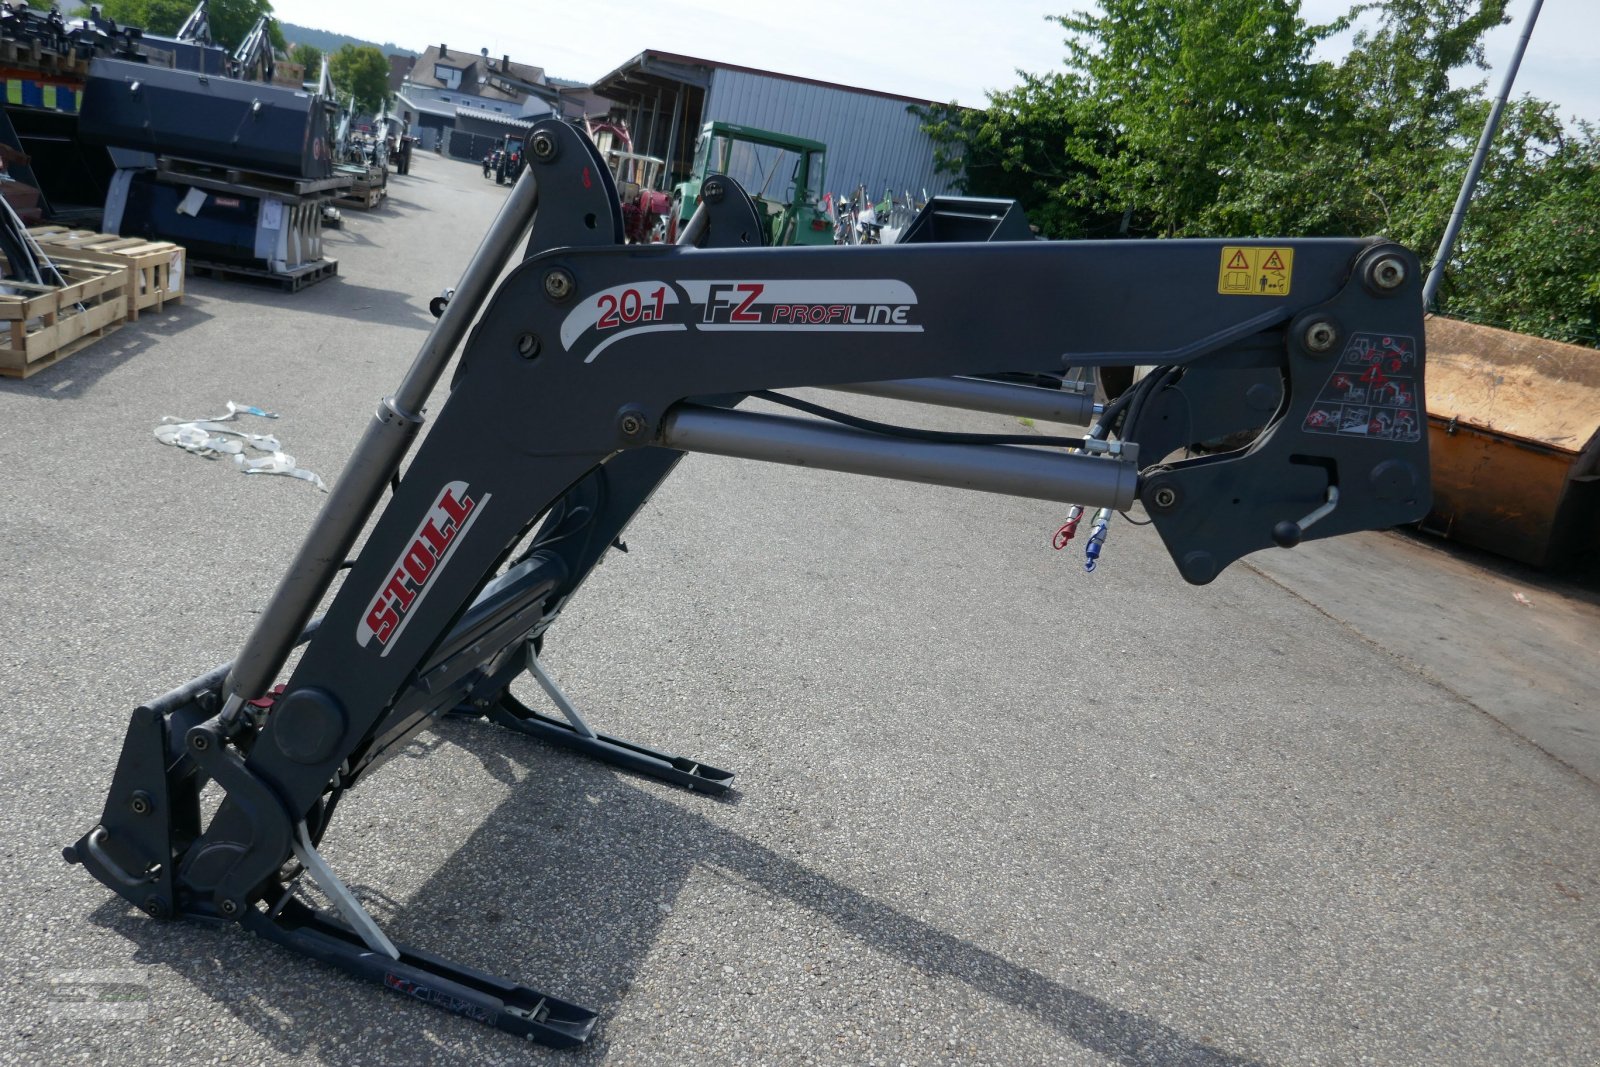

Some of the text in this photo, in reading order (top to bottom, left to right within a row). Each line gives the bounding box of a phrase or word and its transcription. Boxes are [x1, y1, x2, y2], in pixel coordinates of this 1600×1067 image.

[596, 286, 666, 330] 20.1
[703, 283, 765, 324] FZ
[366, 487, 476, 645] STOLL
